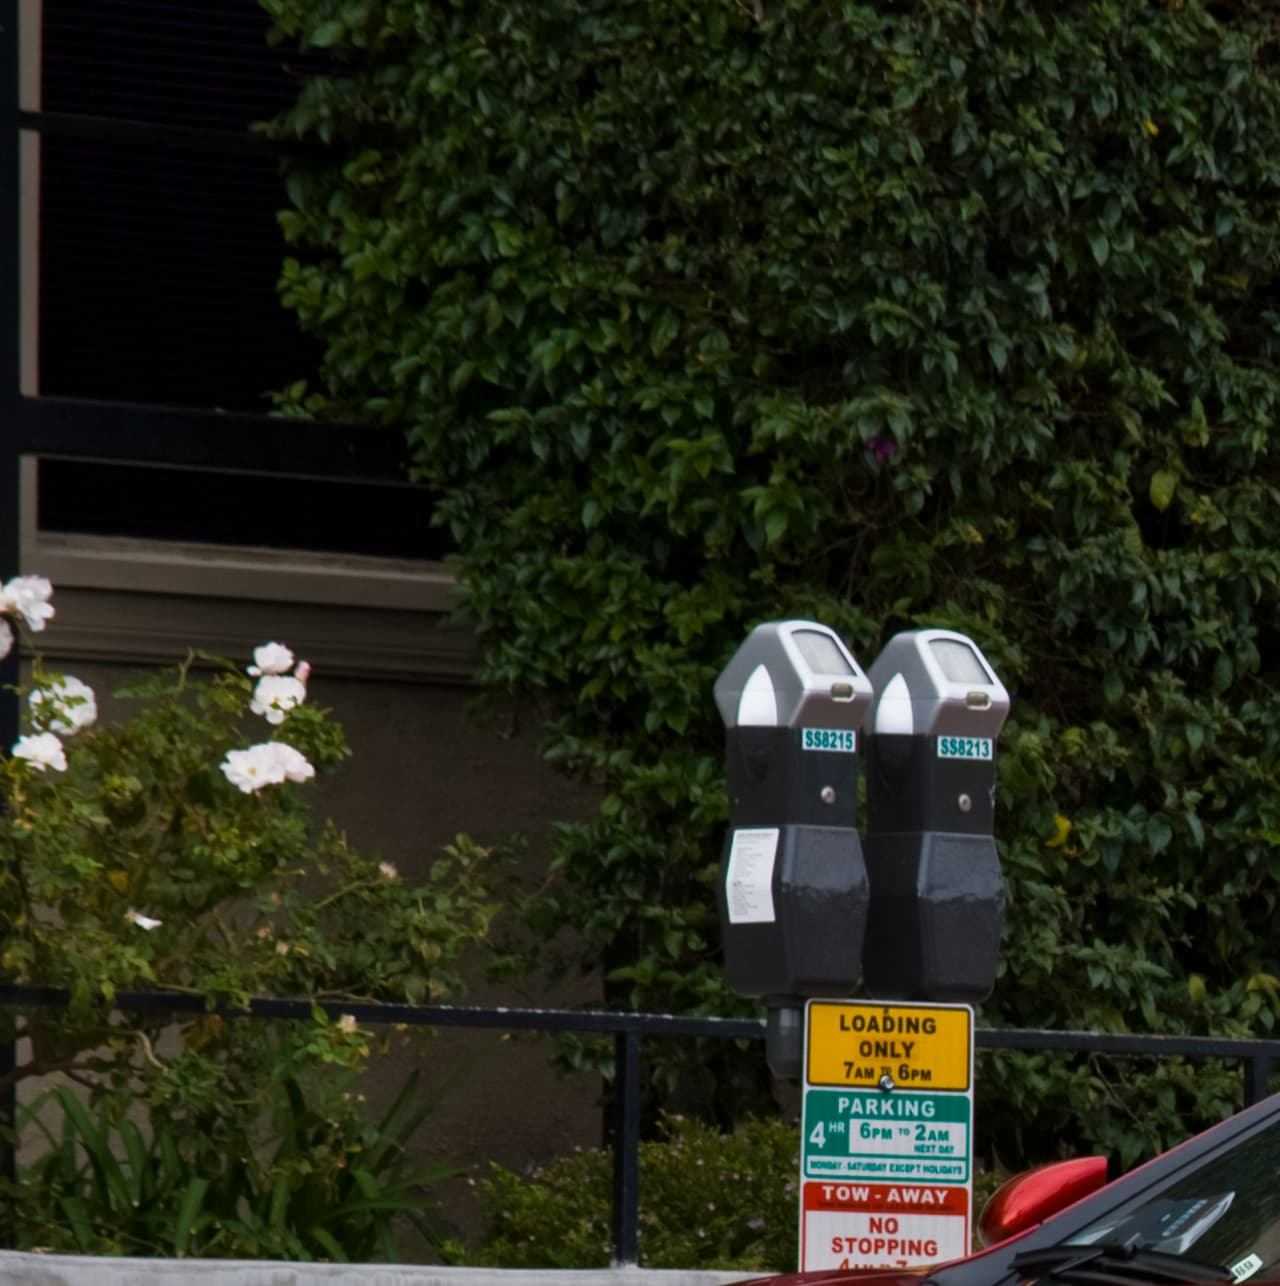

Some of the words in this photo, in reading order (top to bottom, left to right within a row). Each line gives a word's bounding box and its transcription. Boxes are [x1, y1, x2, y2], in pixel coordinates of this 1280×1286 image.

[805, 730, 853, 750] SS8215
[941, 738, 990, 757] SS8213
[840, 1014, 936, 1034] LOADING
[859, 1041, 915, 1058] ONLY
[843, 1062, 874, 1079] 7AM
[898, 1063, 932, 1081] 6PM
[838, 1097, 935, 1117] PARKING
[809, 1121, 826, 1148] 4
[829, 1122, 845, 1133] HR
[860, 1122, 892, 1140] 6PM
[899, 1128, 910, 1136] TO
[915, 1124, 949, 1142] 2AM
[914, 1144, 936, 1153] NEXT
[938, 1145, 954, 1154] DAY
[822, 1185, 869, 1201] TOW
[887, 1188, 949, 1204] AWAY
[869, 1217, 898, 1234] NO
[832, 1237, 938, 1257] STOPPING
